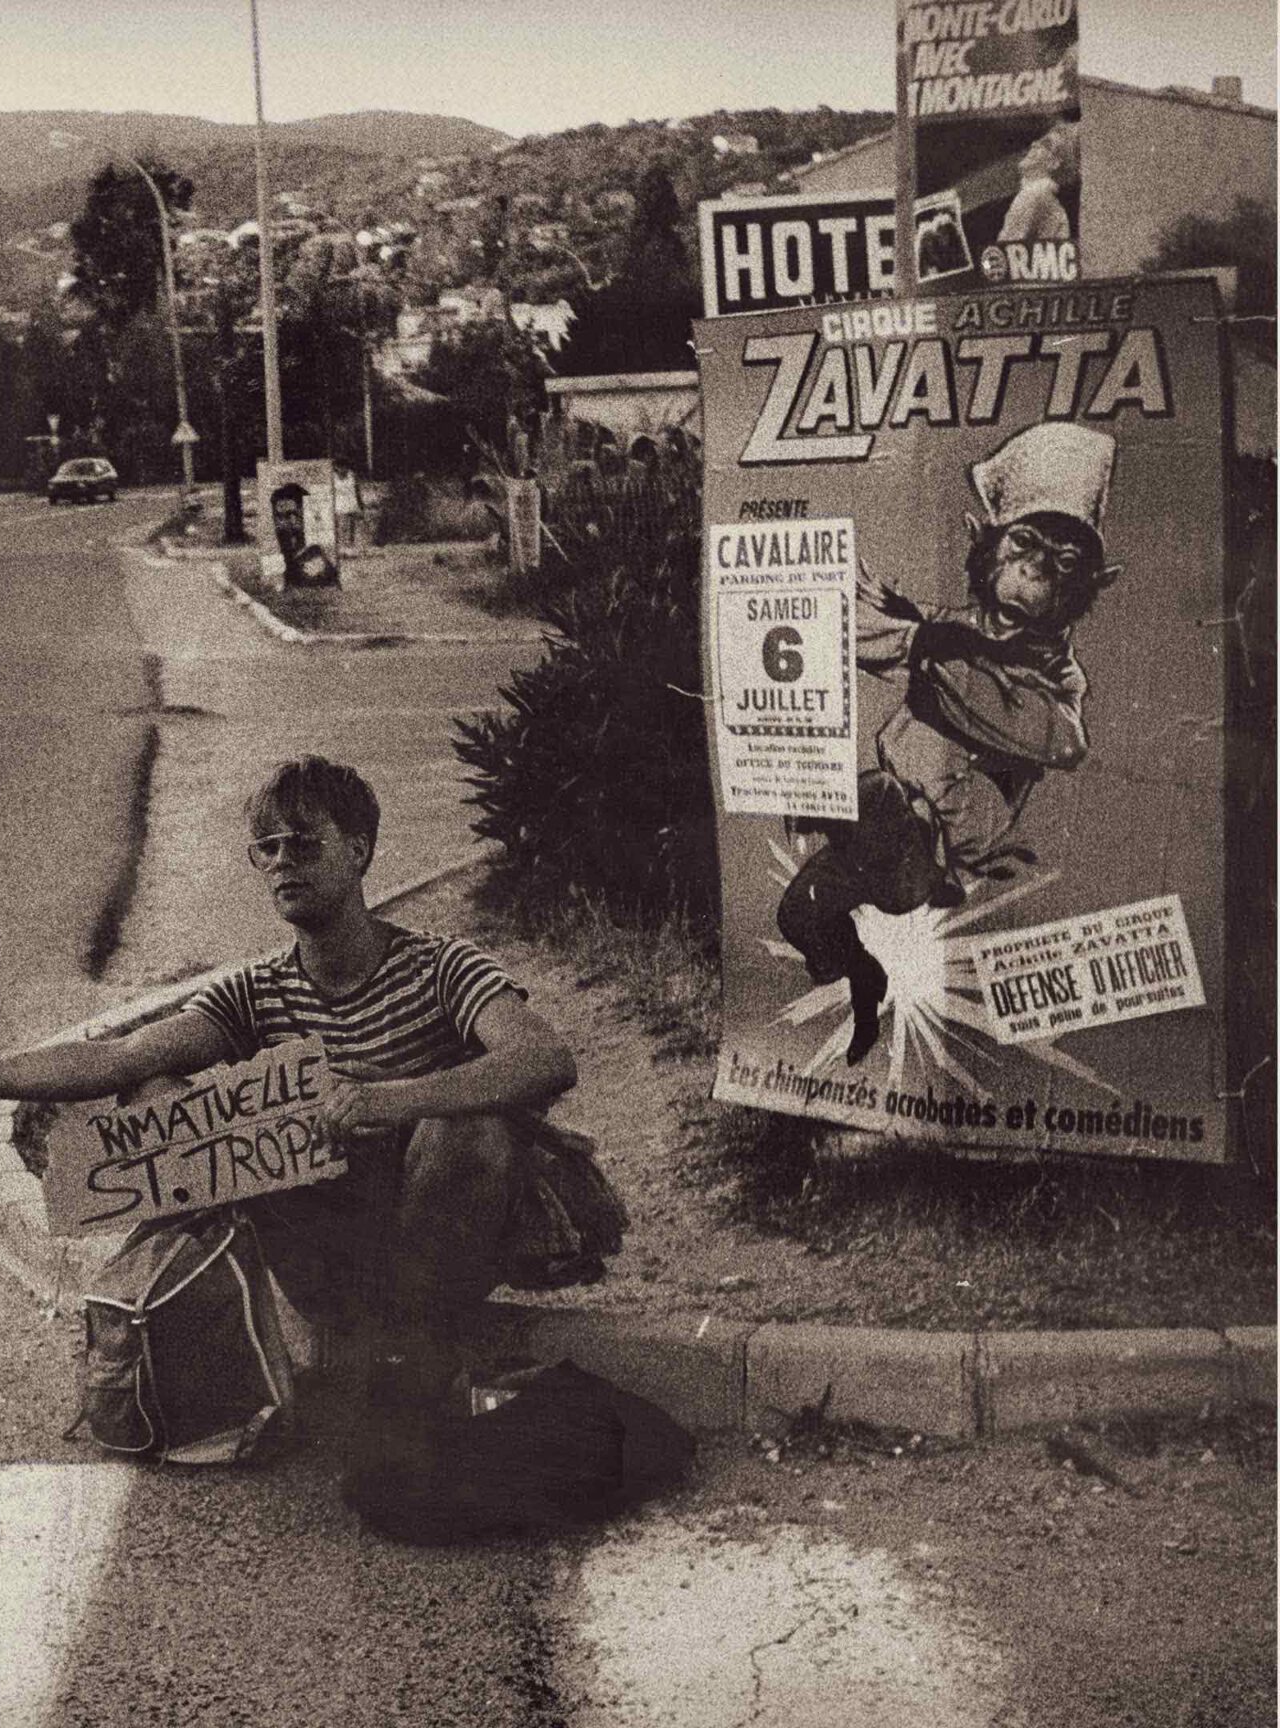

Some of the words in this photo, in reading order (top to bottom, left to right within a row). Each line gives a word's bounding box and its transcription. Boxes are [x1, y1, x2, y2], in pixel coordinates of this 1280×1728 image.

[913, 40, 976, 80] AVEC
[721, 214, 897, 301] HOTE
[1006, 241, 1078, 282] RMC
[822, 303, 938, 342] CIRQUE
[953, 294, 1137, 330] ACHILLE
[739, 327, 1176, 467] ZAVATTA
[717, 529, 848, 568] CAVALAIRE
[747, 597, 818, 621] SAMEDI
[761, 626, 804, 683] 6
[737, 688, 830, 711] JUILLET
[1071, 923, 1171, 955] ZAVATTA
[1082, 921, 1103, 937] DU
[1115, 906, 1174, 929] CIRQUE
[990, 964, 1083, 1019] DEFENSE
[1089, 940, 1188, 996] D'AFFICHER
[1049, 1006, 1083, 1028] peine
[1091, 999, 1108, 1015] de
[885, 1086, 997, 1128] acrobates
[1005, 1098, 1038, 1131] et
[1044, 1099, 1204, 1142] comédiens
[80, 1148, 191, 1226] ST.
[180, 1114, 327, 1200] TROPE
